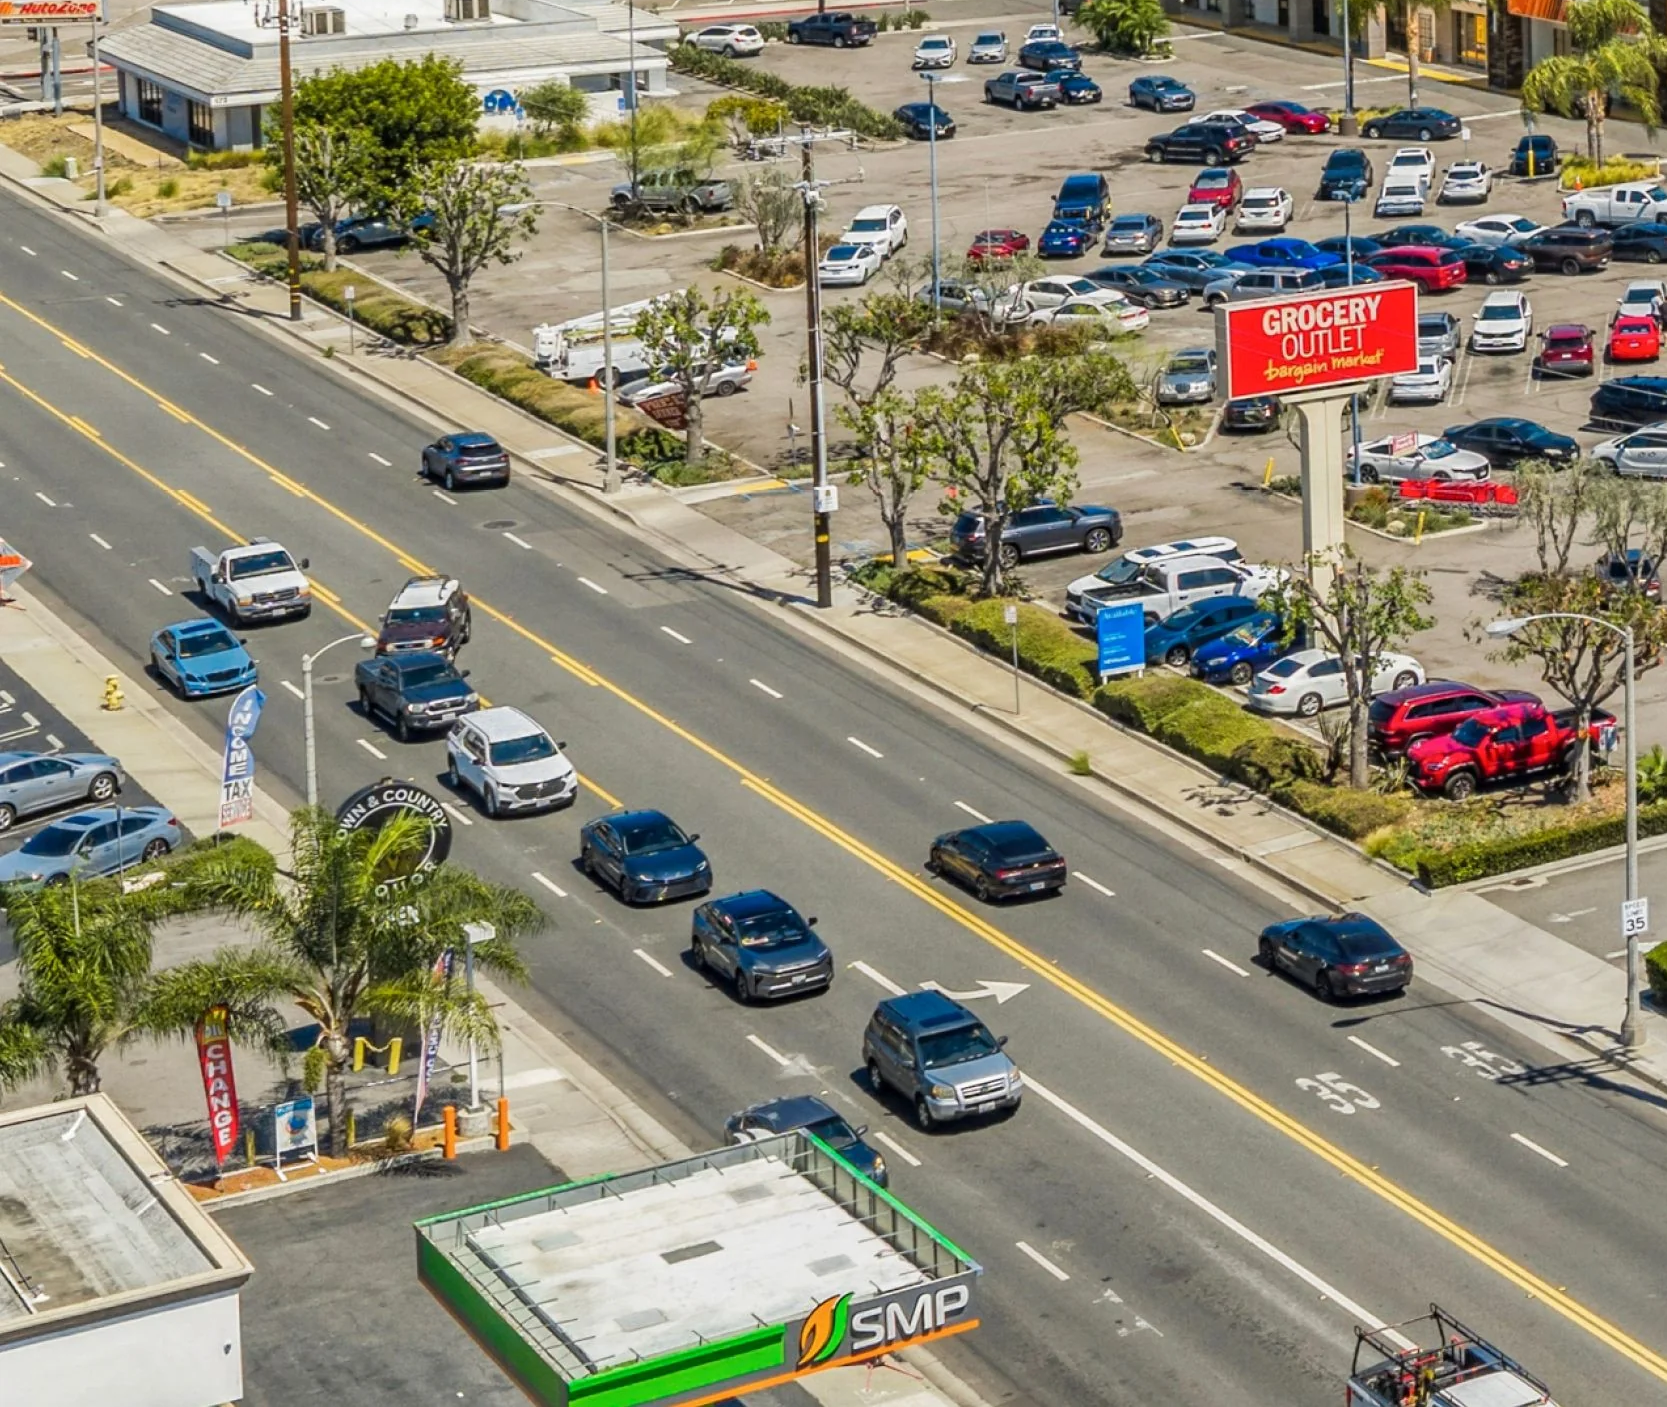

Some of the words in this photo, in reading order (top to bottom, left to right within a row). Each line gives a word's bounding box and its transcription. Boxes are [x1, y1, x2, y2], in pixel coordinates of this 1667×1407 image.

[20, 1, 97, 14] AutoZone
[1262, 294, 1383, 336] GROCERY
[1281, 322, 1367, 361] OUTLET
[1263, 358, 1328, 384] bargain
[1331, 349, 1384, 370] market
[228, 697, 254, 776] INCOME
[223, 779, 252, 802] TAX
[366, 795, 380, 809] &
[383, 789, 448, 828] COUNTRY
[1626, 917, 1646, 932] 35
[1440, 1041, 1526, 1080] 35
[205, 1044, 233, 1147] CHANGE
[1295, 1072, 1381, 1114] 35
[850, 1284, 970, 1351] SMP
